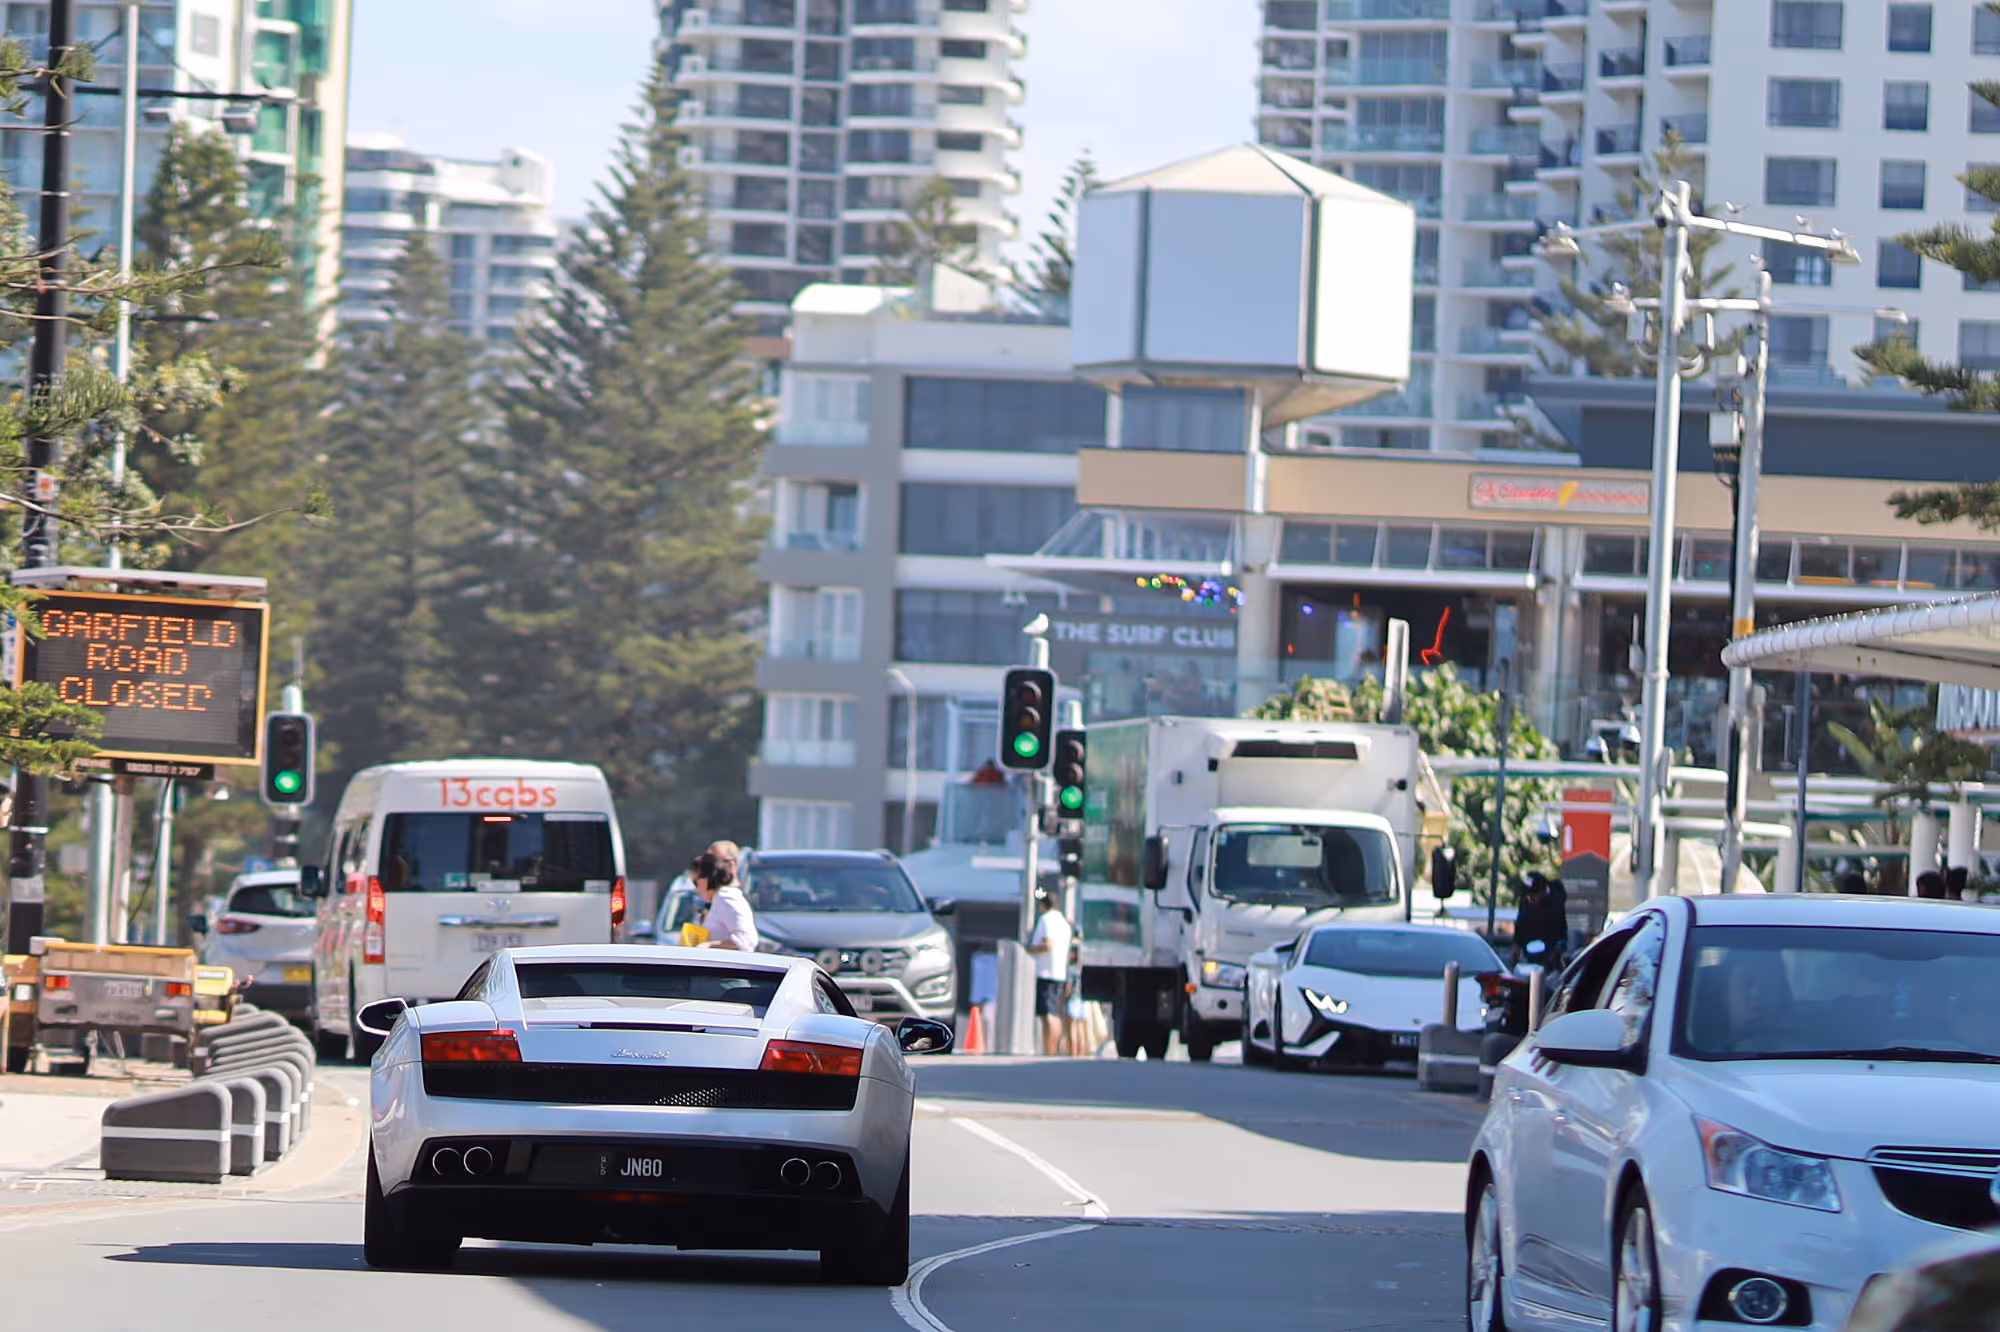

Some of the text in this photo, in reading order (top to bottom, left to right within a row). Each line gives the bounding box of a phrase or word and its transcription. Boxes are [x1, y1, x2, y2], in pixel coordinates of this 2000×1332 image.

[41, 609, 237, 648] GARFIELD
[1053, 621, 1235, 649] THE SURF CLUB
[86, 643, 189, 675] ROAD
[58, 676, 213, 712] CLOSED
[440, 777, 558, 808] 13cabs
[620, 1157, 663, 1178] JN80
